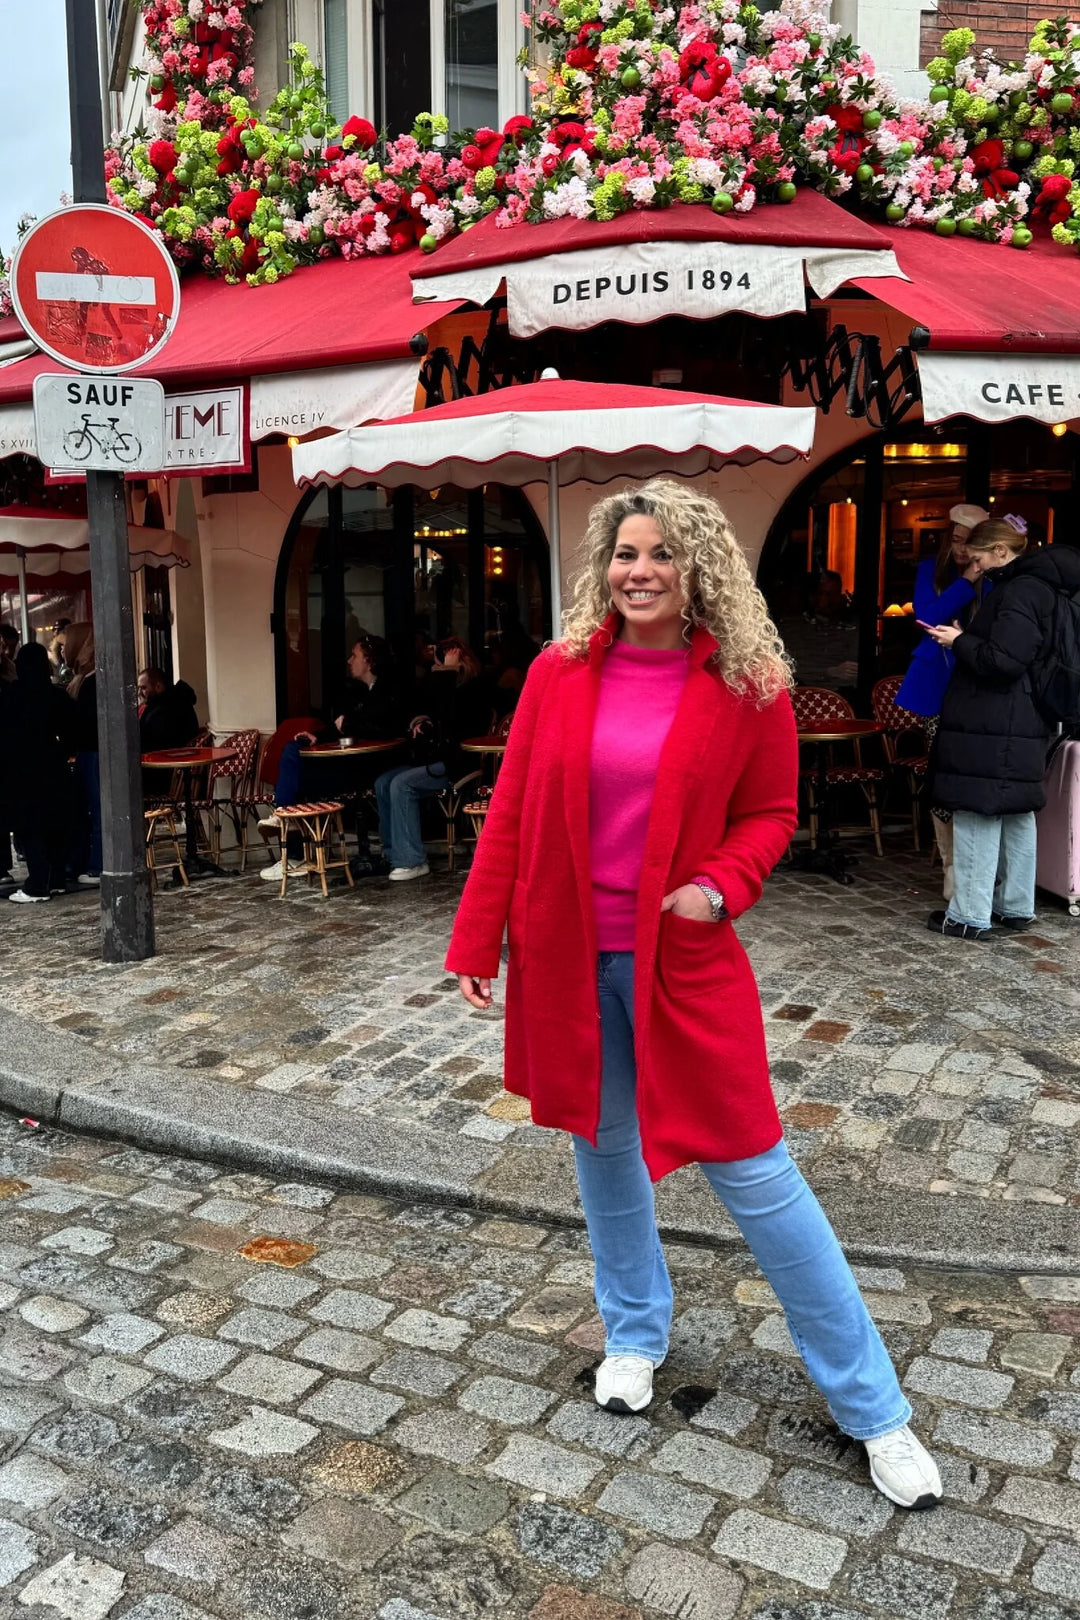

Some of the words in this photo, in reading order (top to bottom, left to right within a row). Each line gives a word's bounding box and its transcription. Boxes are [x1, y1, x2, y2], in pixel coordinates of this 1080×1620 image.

[553, 271, 669, 304] DEPUIS
[687, 269, 751, 291] 1894
[67, 383, 134, 407] SAUF
[981, 382, 1064, 406] CAFE
[256, 413, 306, 429] LICENCE
[312, 412, 325, 423] IV
[11, 439, 37, 449] XVII
